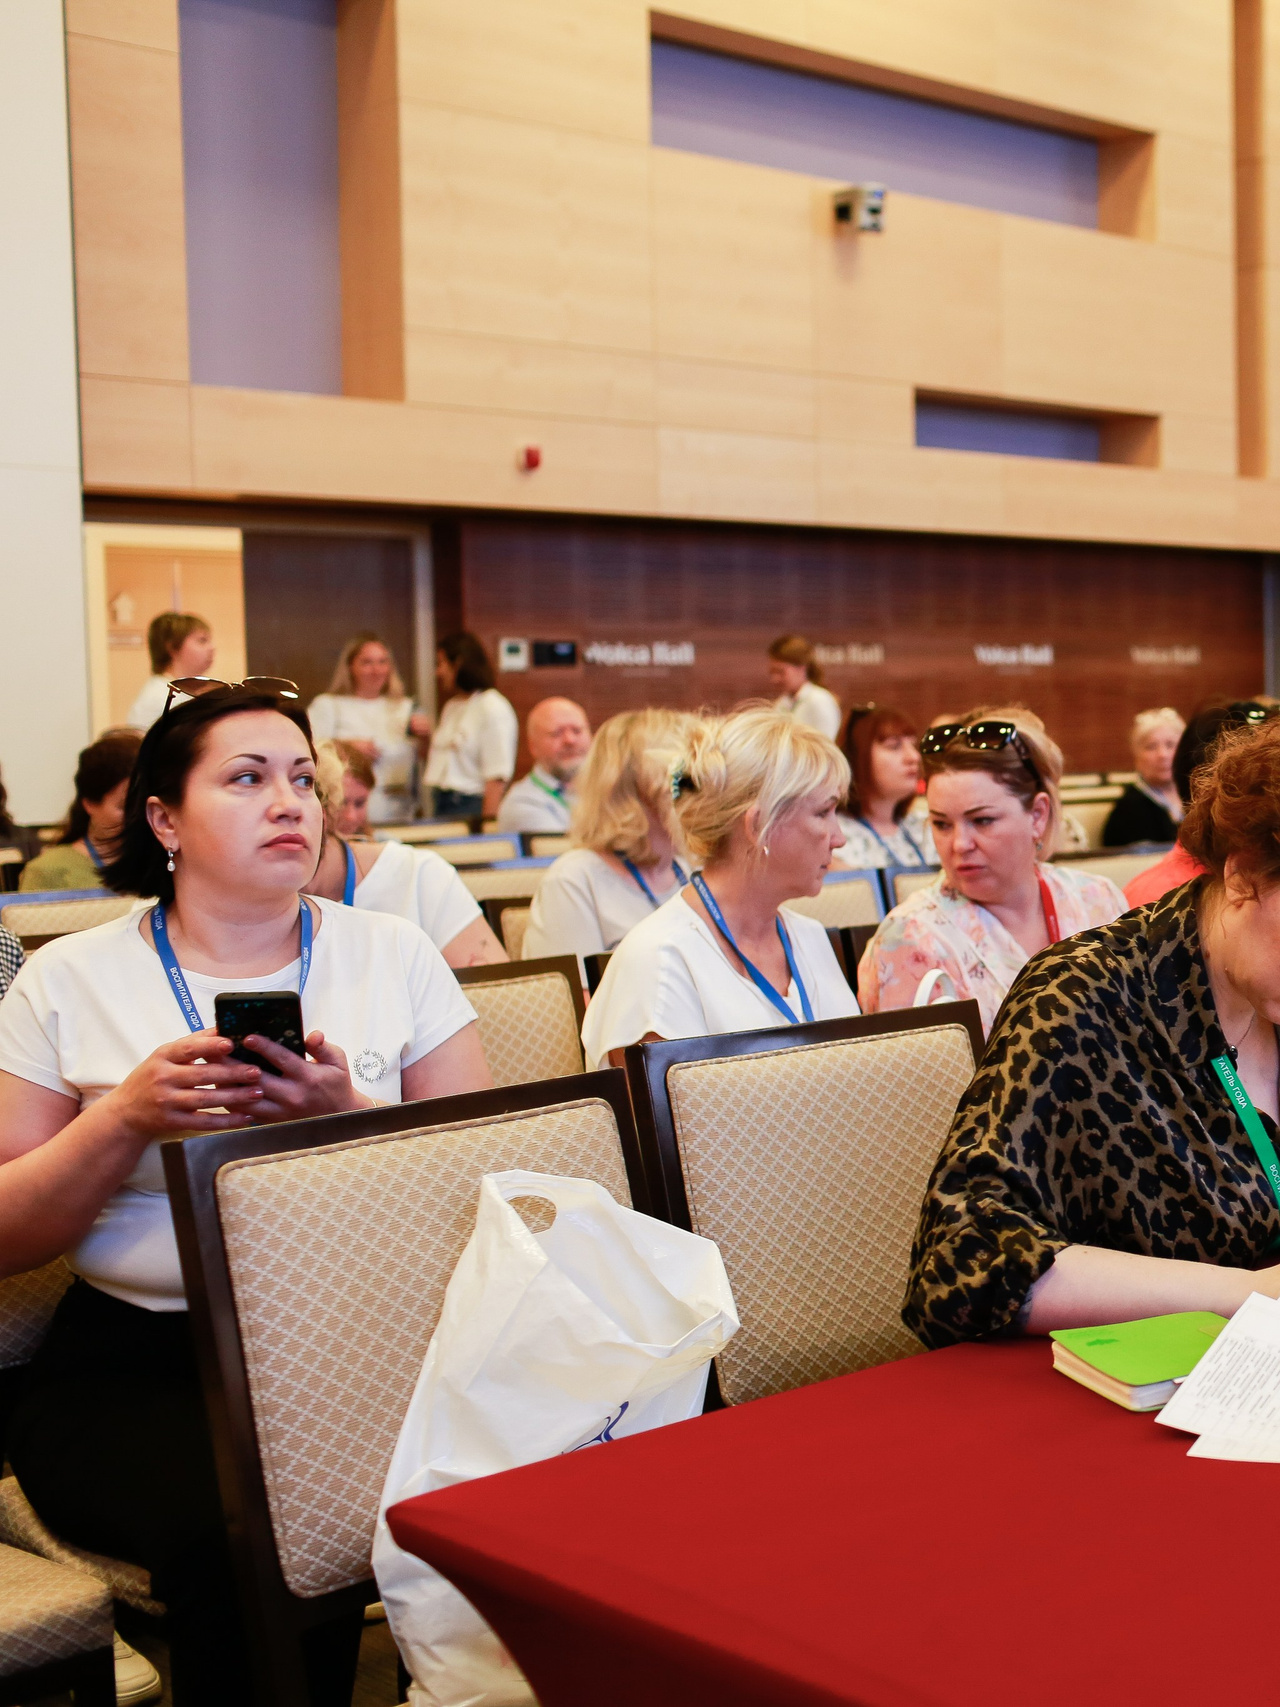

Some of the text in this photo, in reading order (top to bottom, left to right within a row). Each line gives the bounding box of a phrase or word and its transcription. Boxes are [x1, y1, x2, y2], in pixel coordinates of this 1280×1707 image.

[170, 966, 201, 1028] ВОСПИТАТЕЛЬ ГОДА
[1217, 1056, 1248, 1109] ТАТЕЛЬ ГОДА
